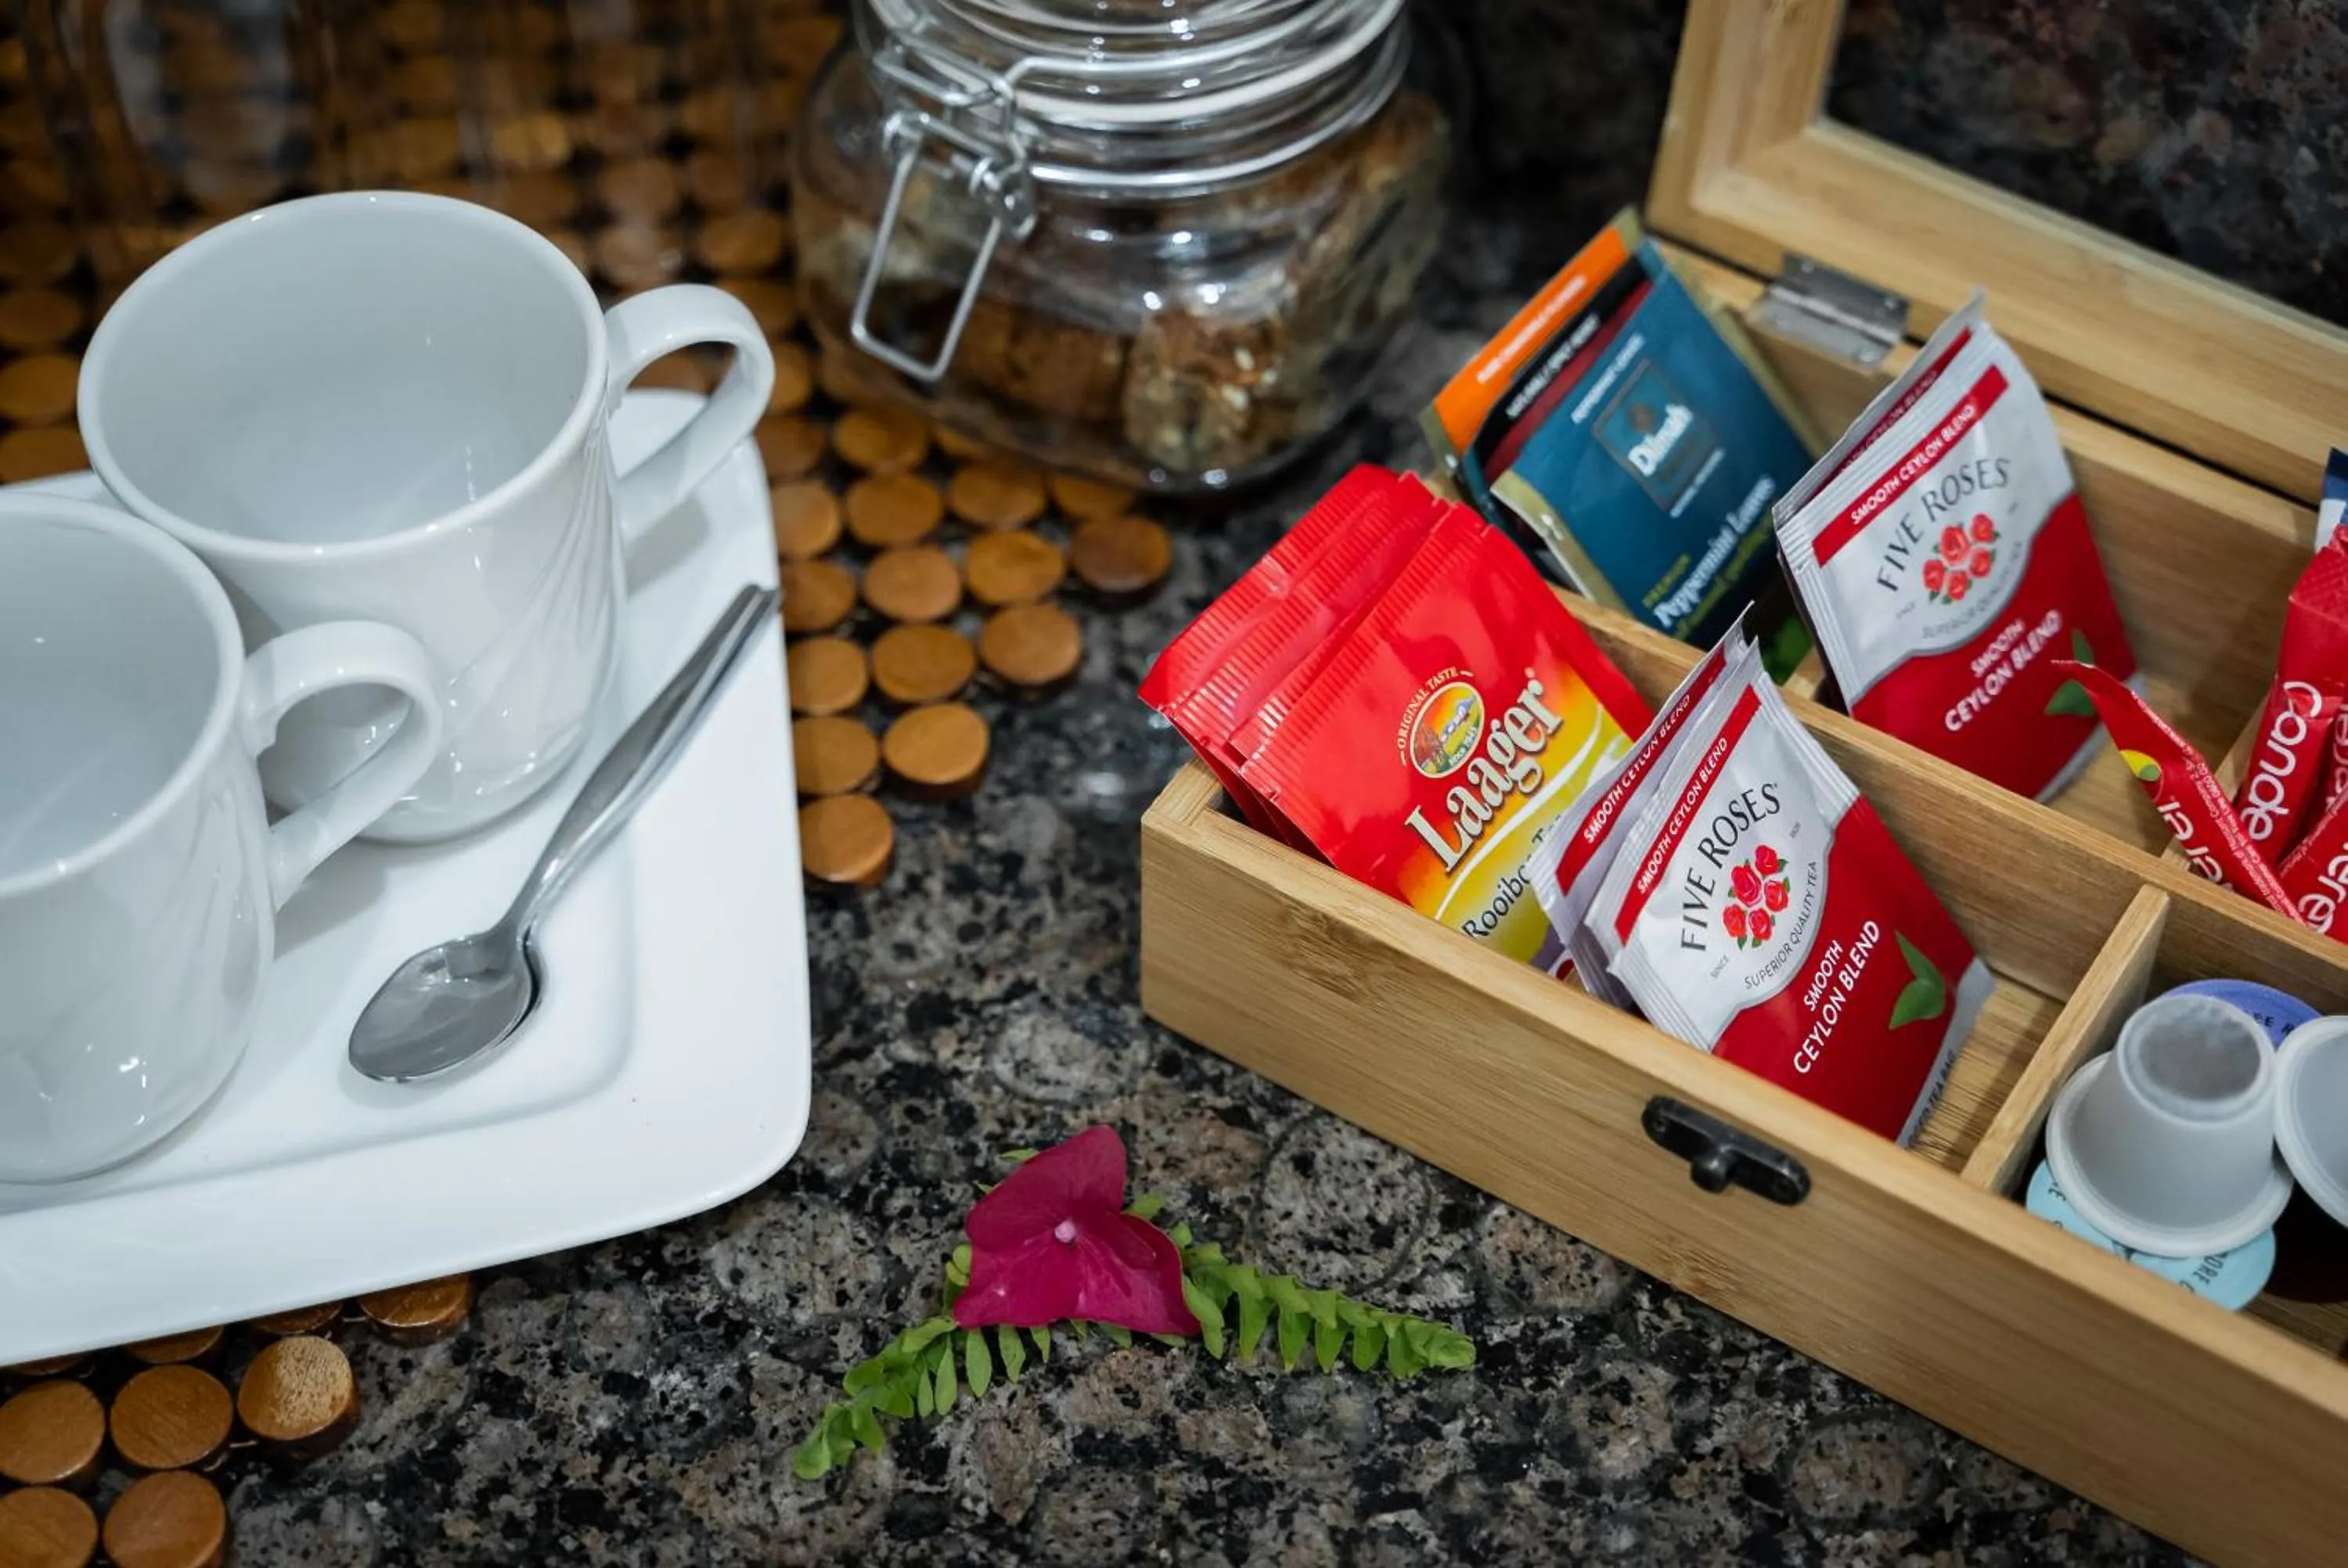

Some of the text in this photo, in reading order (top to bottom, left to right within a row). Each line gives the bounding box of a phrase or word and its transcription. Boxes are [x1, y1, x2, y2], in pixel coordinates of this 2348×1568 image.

[1851, 476, 1900, 524] SMOOTH
[1900, 437, 1943, 481] CEYLON
[1941, 403, 1976, 443] BLEND
[1877, 458, 2011, 592] FIVE ROSES
[1653, 523, 1740, 628] Peppermint
[1397, 667, 1459, 750] ORIGINAL TASTE
[1945, 609, 2062, 731] CEYLON BLEND
[1971, 618, 2026, 678] SMOOTH
[1404, 679, 1564, 874] Laager
[1583, 694, 1691, 843] SMOOTH CEYLON BLEND
[1637, 738, 1727, 895] SMOOTH CEYLON BLEND
[2240, 681, 2322, 841] Cande
[1461, 854, 1532, 938] Rooibo
[1680, 782, 1781, 951] FIVE ROSES
[1745, 861, 1817, 990] SUPERIOR QUALITY TEA
[1793, 920, 1880, 1074] CEYLON BLEND
[1803, 940, 1844, 1012] SMOOTH
